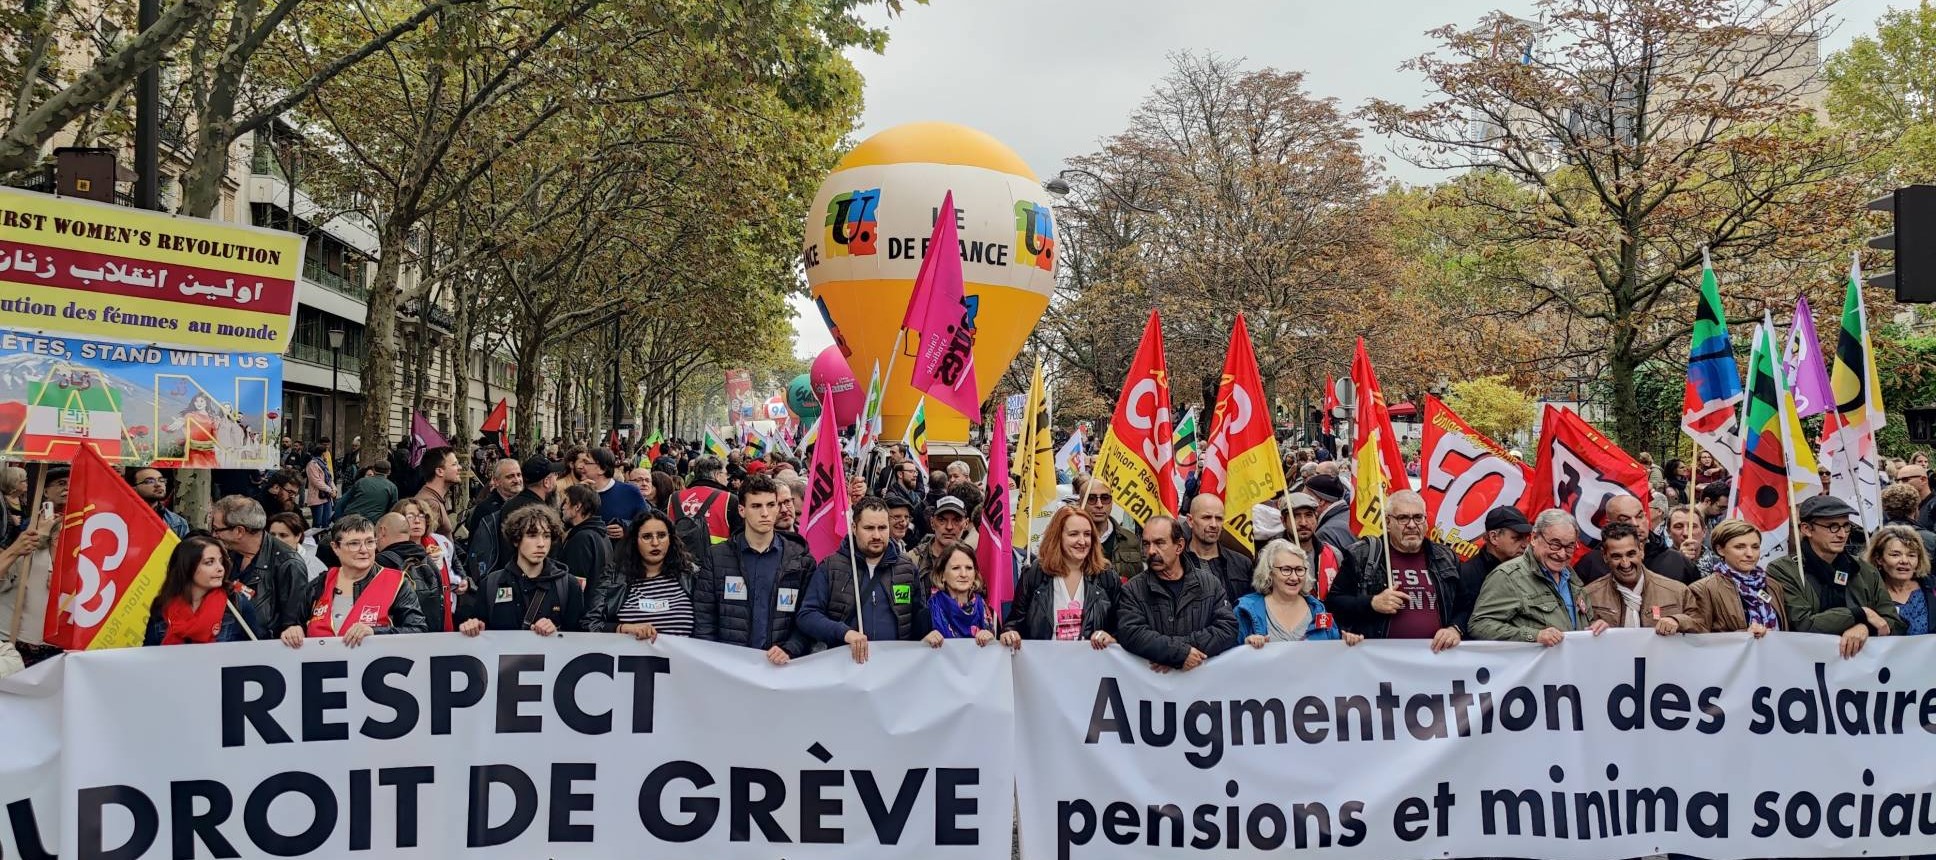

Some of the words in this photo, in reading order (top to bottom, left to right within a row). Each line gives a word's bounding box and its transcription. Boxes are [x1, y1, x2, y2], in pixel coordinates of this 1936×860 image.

[932, 206, 965, 230] IE
[54, 217, 151, 247] WOMEN'S
[158, 233, 281, 266] REVOLUTION
[888, 237, 916, 260] DE
[921, 238, 1008, 267] FANCE
[62, 302, 97, 321] des
[103, 305, 178, 330] fémmes
[188, 320, 211, 334] au
[217, 323, 278, 342] monde
[0, 334, 72, 360] ETES,
[81, 343, 161, 365] STAND
[170, 350, 230, 368] WITH
[239, 355, 269, 370] US
[1137, 468, 1160, 502] Régio
[1402, 591, 1437, 610] NY
[220, 652, 670, 748] RESPECT
[1084, 666, 1585, 770] Augmentation
[1606, 656, 1726, 735] des
[77, 764, 435, 860] DROIT
[466, 762, 597, 849] DE
[637, 741, 980, 846] GRÈVE
[1057, 779, 1368, 860] pensions
[1392, 781, 1456, 843] et
[1480, 762, 1729, 841] minima
